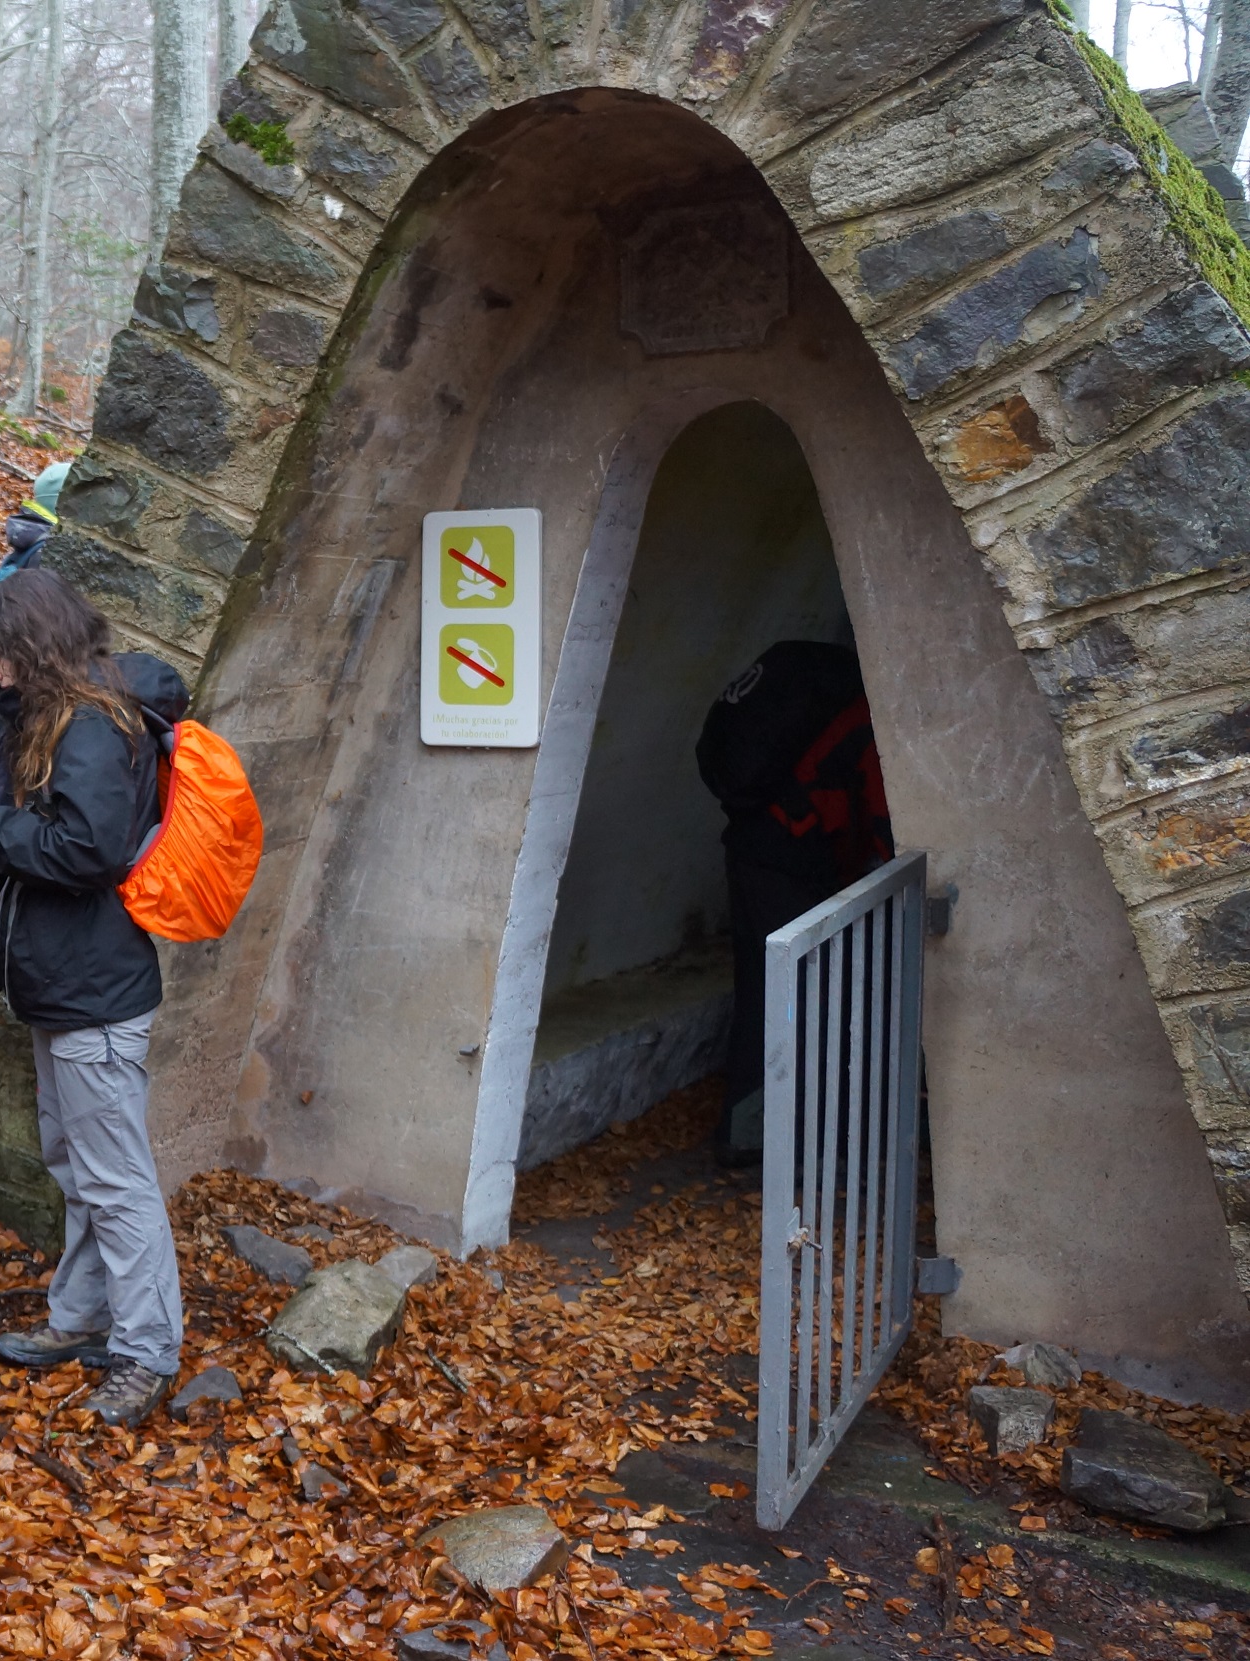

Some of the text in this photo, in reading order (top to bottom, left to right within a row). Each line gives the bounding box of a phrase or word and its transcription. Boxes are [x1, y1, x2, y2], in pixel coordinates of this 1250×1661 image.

[432, 713, 519, 727] ¡Muchas gracias por
[441, 728, 509, 739] tu colaboración!
